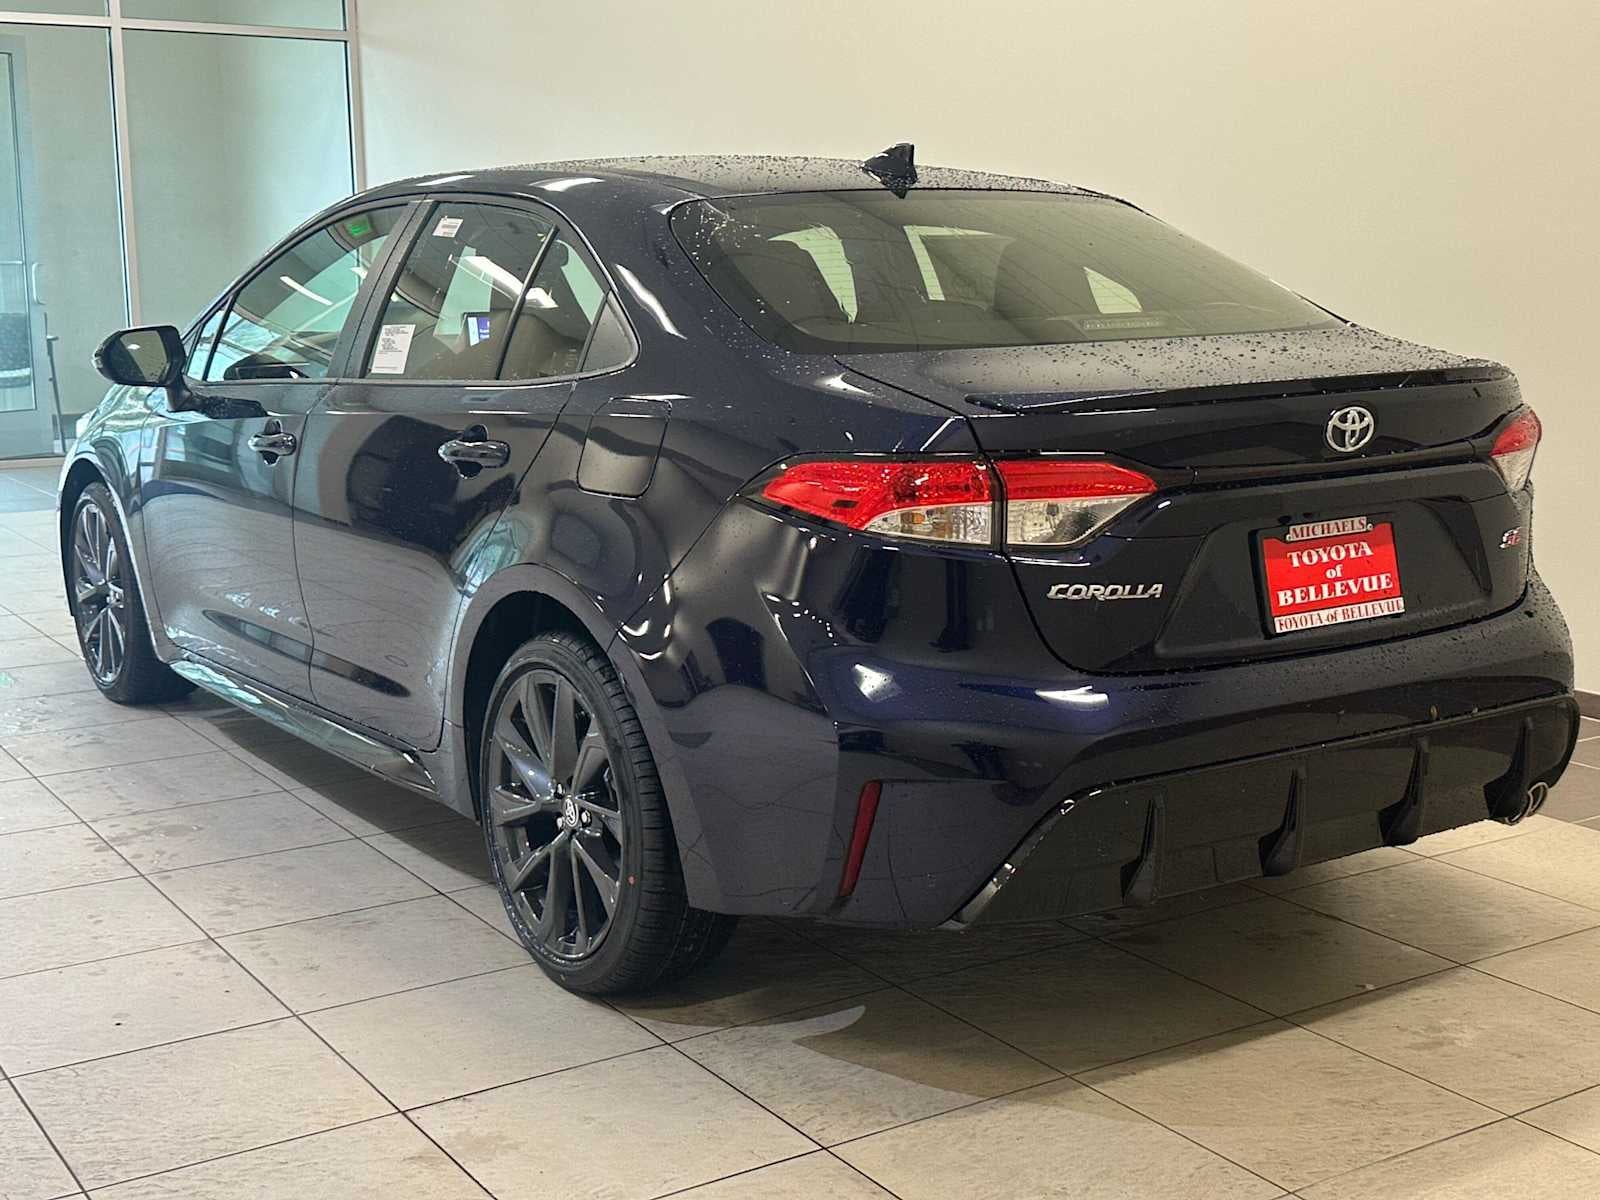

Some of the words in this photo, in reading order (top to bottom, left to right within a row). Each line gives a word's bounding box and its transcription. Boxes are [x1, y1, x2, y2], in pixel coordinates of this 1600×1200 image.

[1287, 541, 1373, 568] TOYOTA
[1325, 564, 1343, 579] of
[1046, 583, 1163, 601] COROLLA
[1276, 573, 1393, 607] BELLEVUE
[1276, 613, 1324, 632] TOYOTA
[1326, 610, 1339, 623] of
[1342, 599, 1404, 620] BELLEVUE
